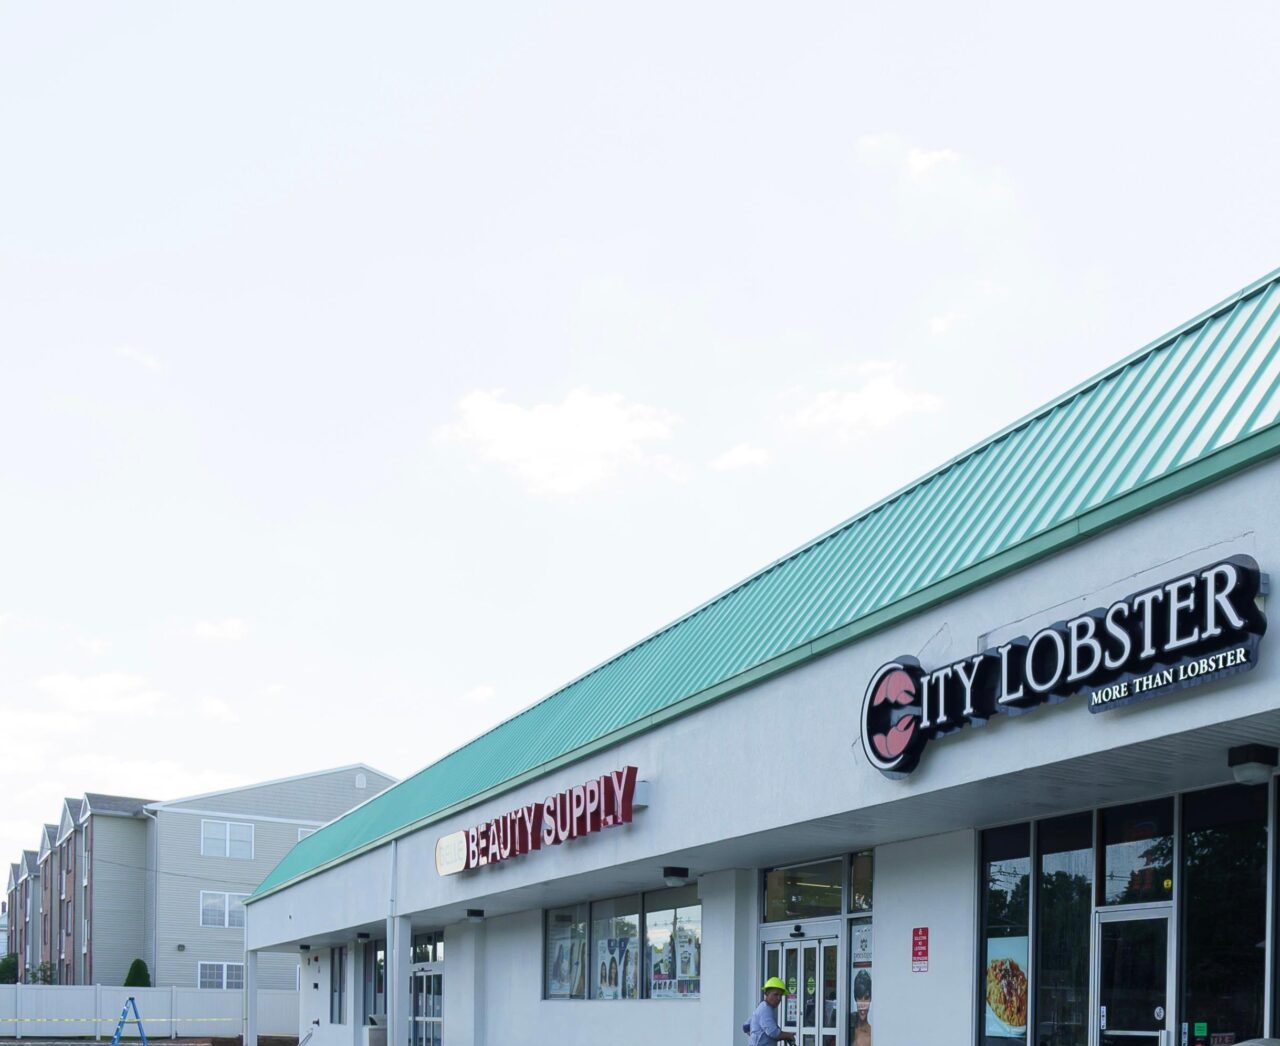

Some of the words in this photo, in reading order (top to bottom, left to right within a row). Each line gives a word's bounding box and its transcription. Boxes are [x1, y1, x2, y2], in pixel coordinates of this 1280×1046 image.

[859, 656, 984, 770] CITY
[998, 562, 1246, 704] LOBSTER
[1091, 682, 1128, 706] MORE
[1132, 670, 1174, 692] THAN
[1178, 647, 1247, 681] LOBSTER
[468, 803, 543, 868] BEAUTY
[543, 766, 638, 845] SUPPLY
